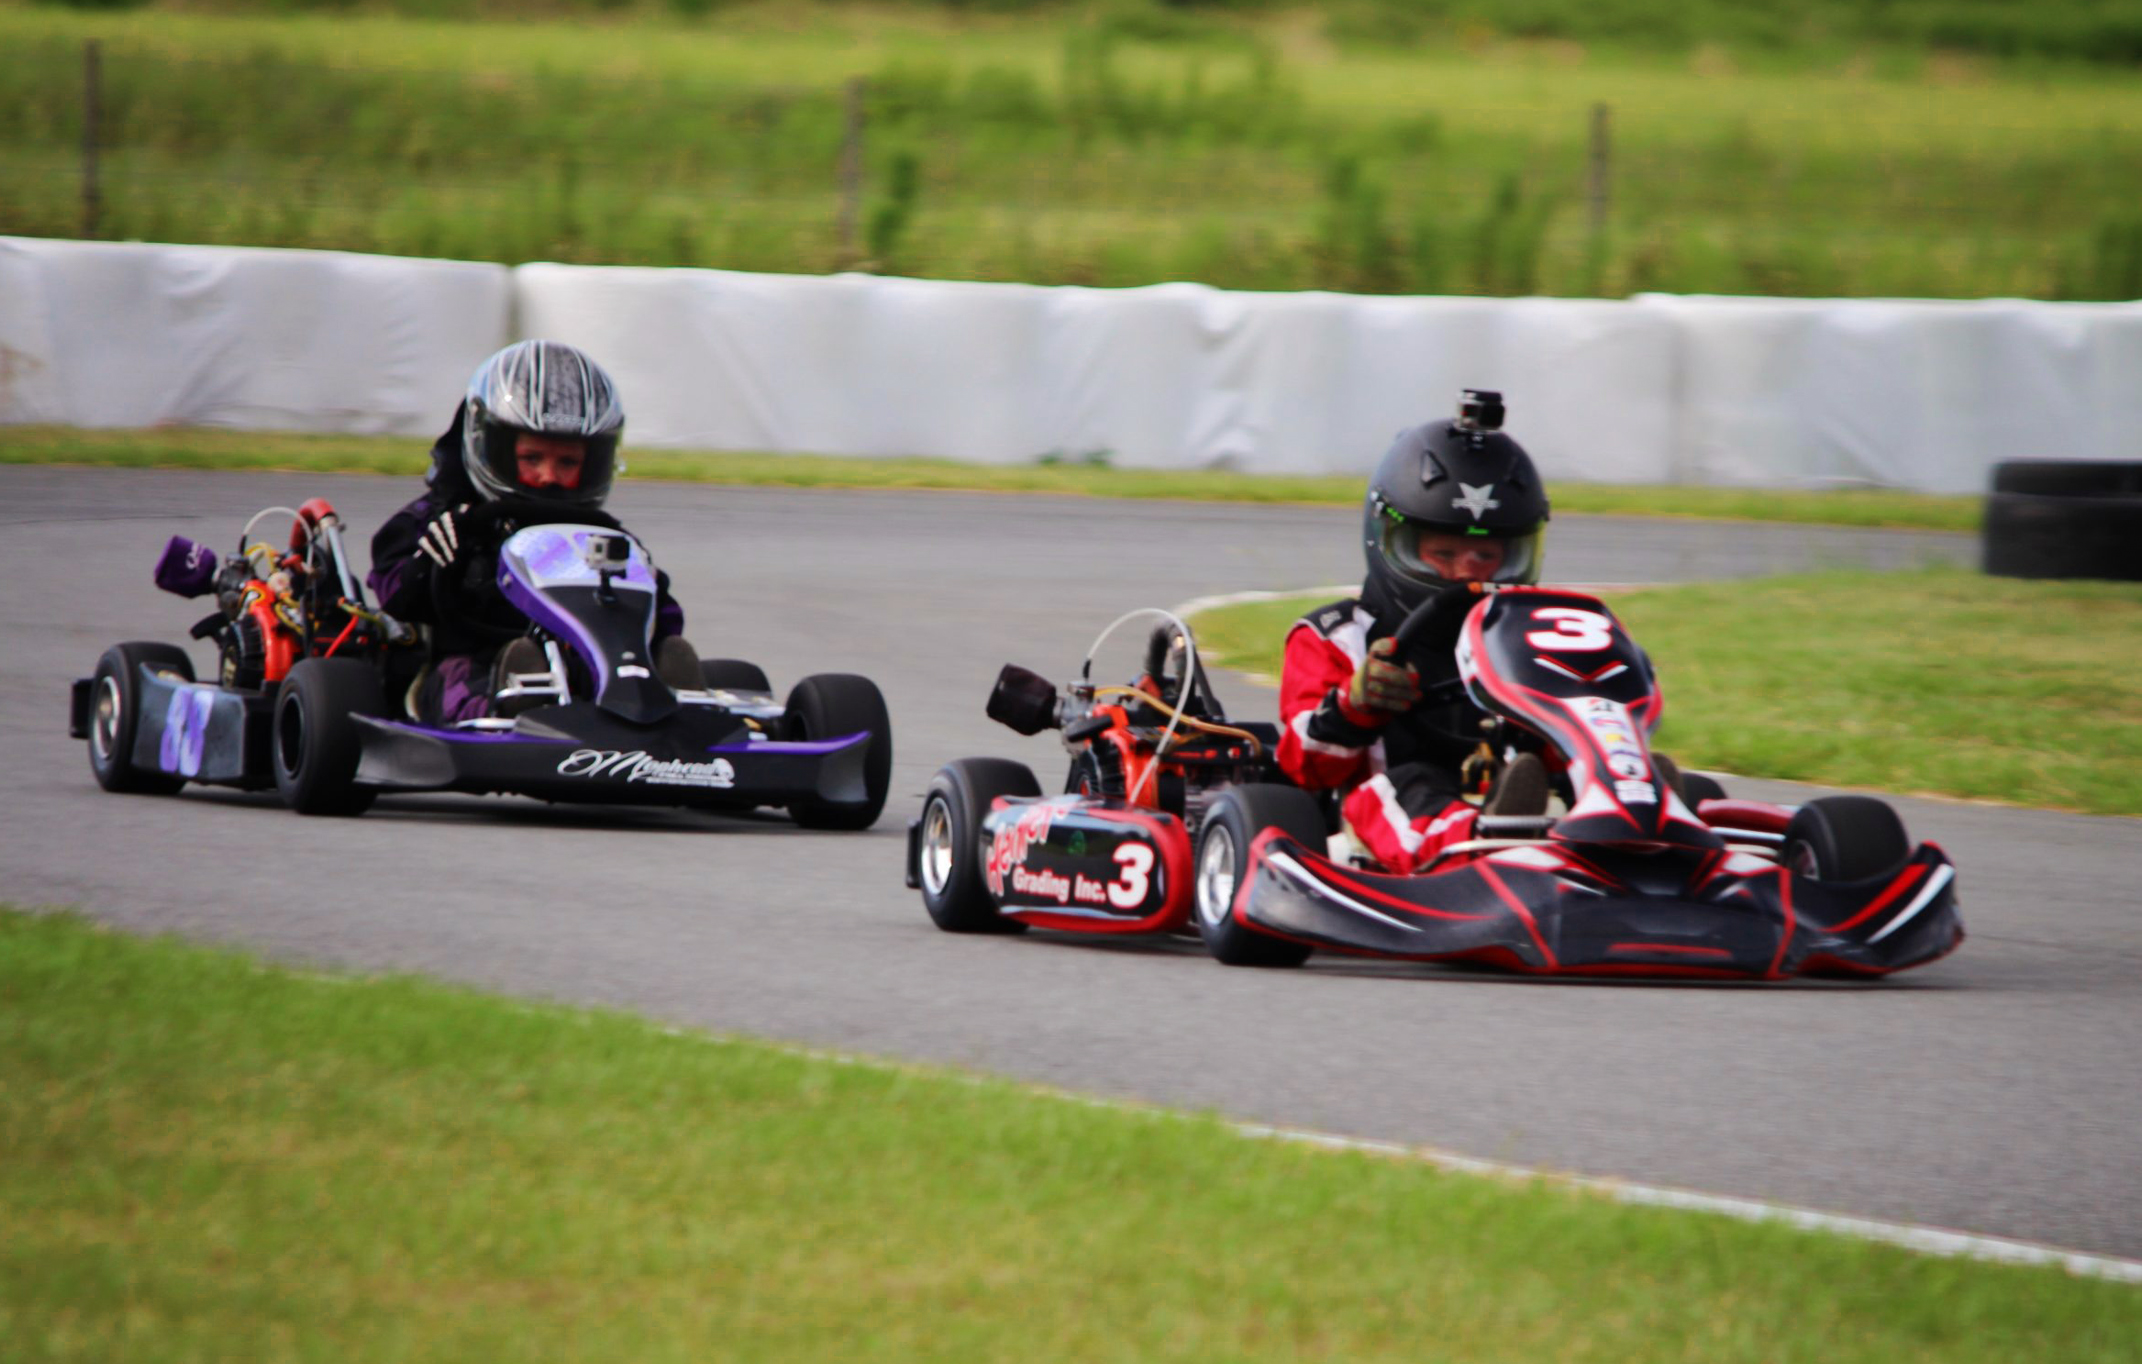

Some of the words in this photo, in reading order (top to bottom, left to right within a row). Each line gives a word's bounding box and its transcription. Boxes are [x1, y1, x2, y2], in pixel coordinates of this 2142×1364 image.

[1525, 607, 1612, 652] 3
[1012, 866, 1070, 903] Grading
[1074, 873, 1107, 902] Inc.
[1107, 841, 1155, 909] 3
